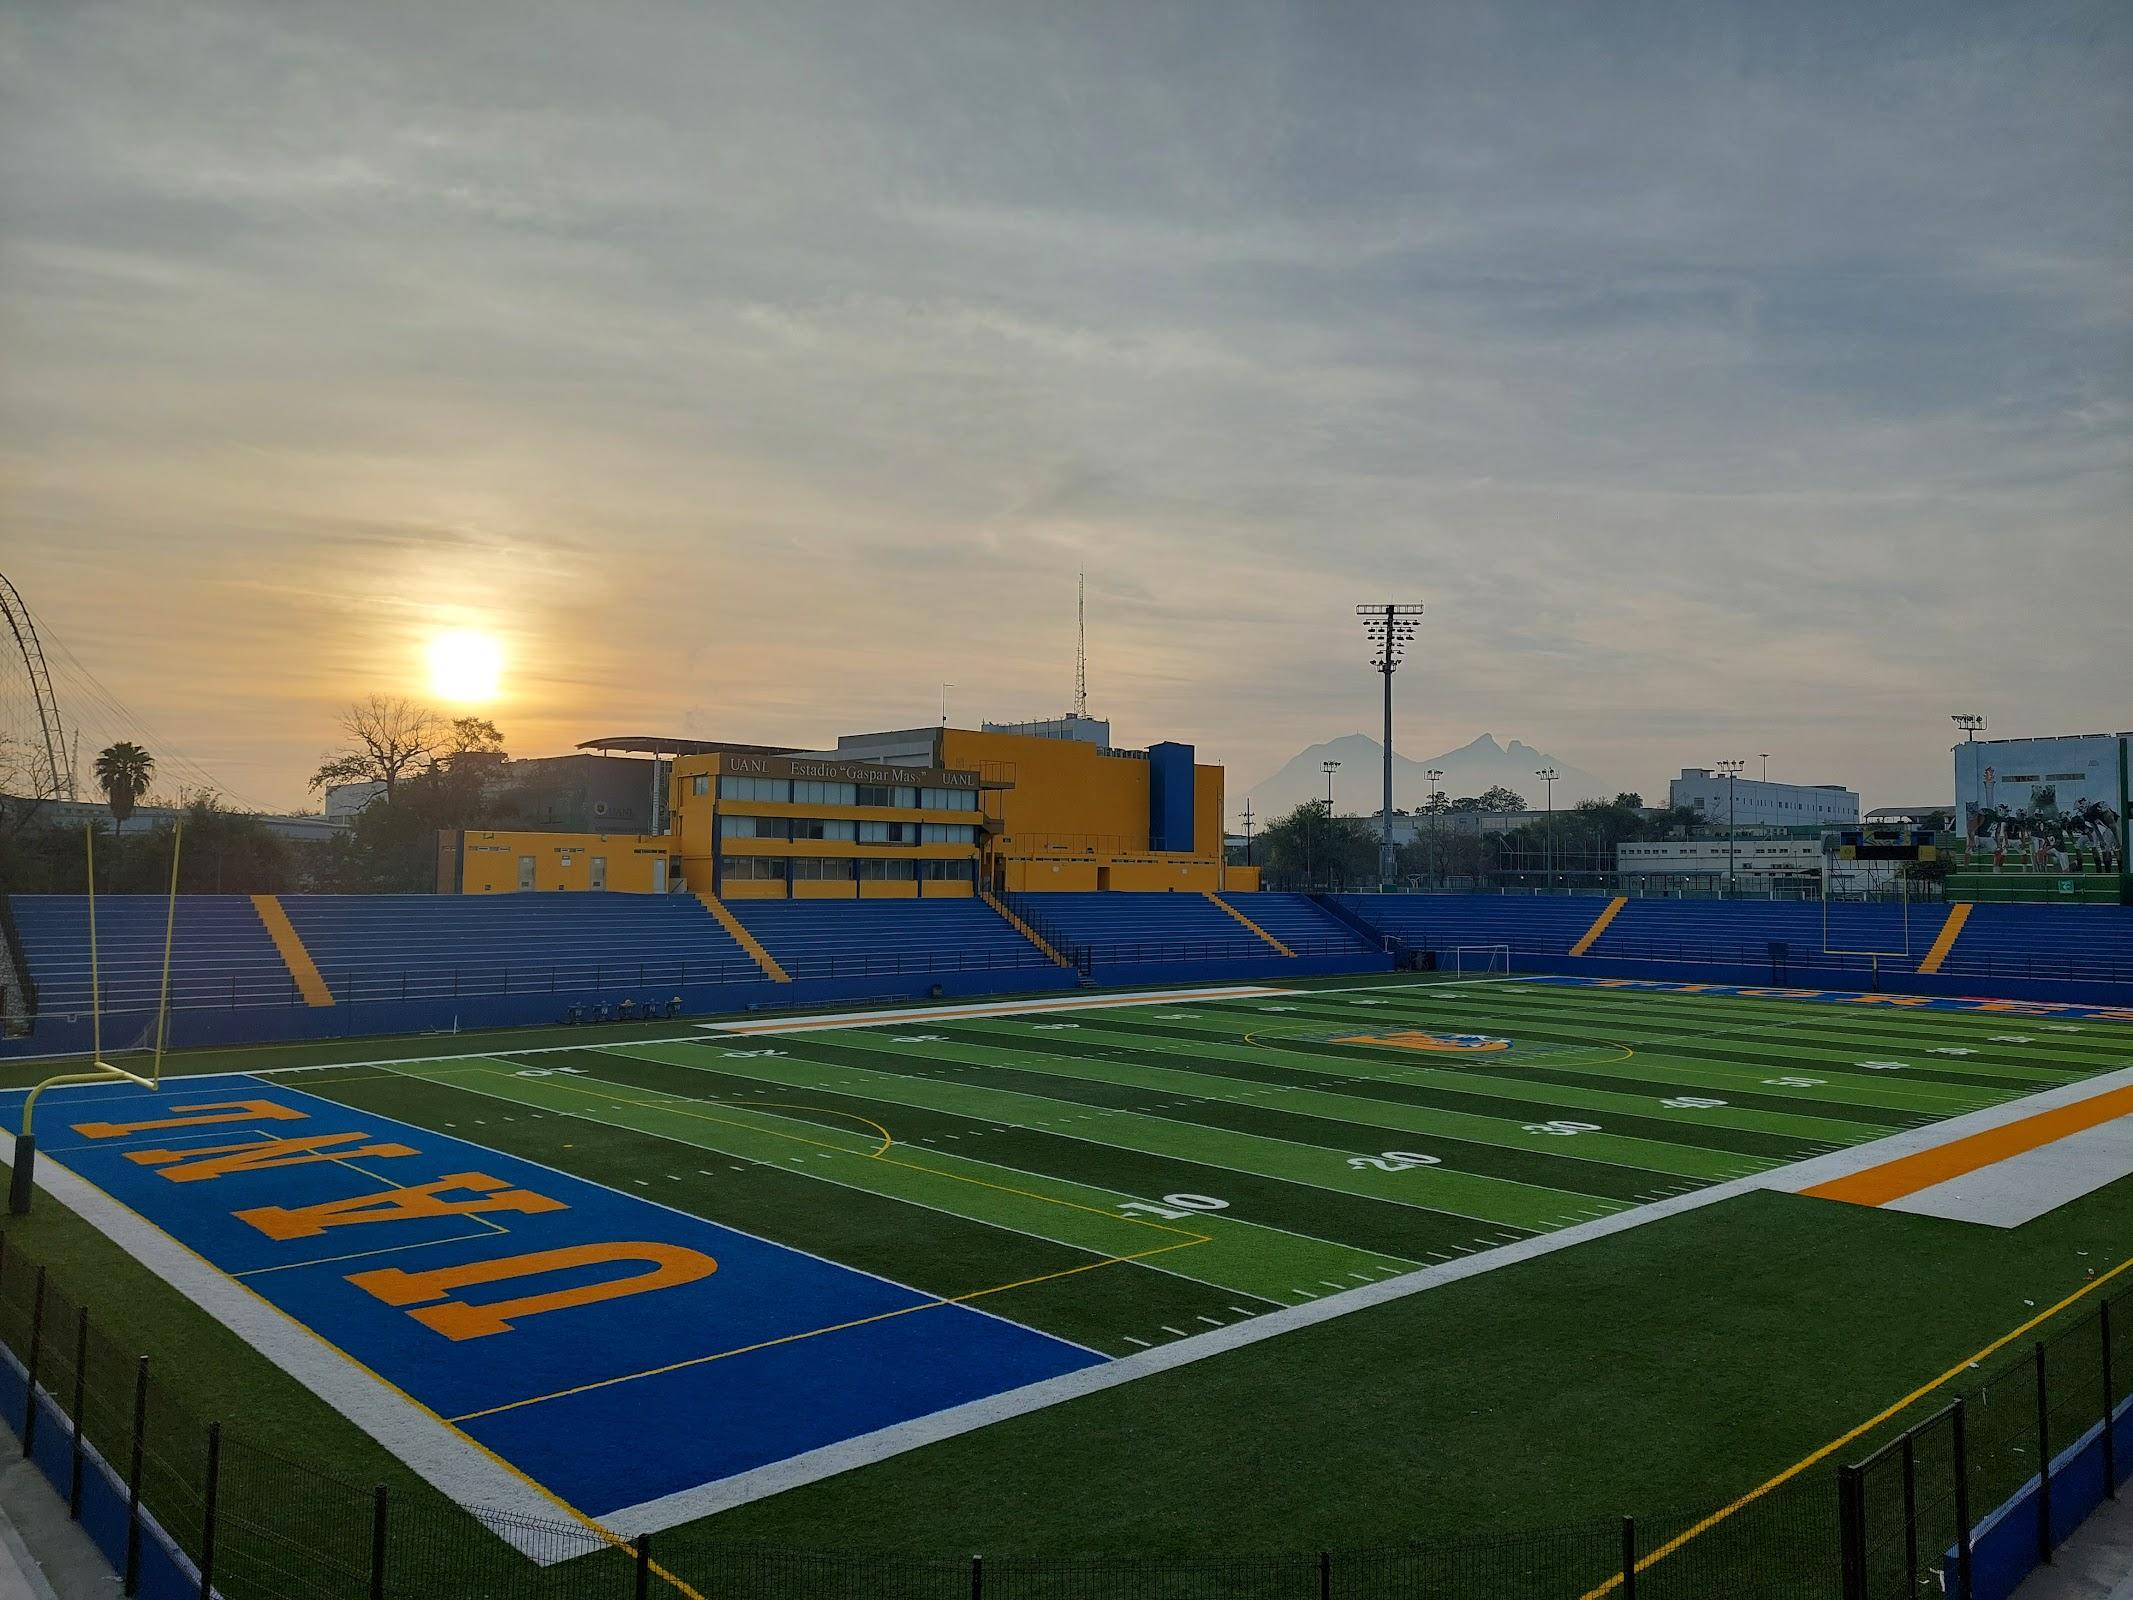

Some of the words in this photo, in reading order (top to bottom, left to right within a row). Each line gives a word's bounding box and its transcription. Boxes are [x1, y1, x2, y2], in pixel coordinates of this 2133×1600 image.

[730, 758, 770, 774] UANL
[791, 762, 837, 778] Estadio
[942, 773, 974, 787] UANL
[717, 1048, 790, 1059] 20
[514, 1066, 589, 1077] 10
[1760, 1076, 1829, 1088] 50
[1658, 1096, 1729, 1110] 40
[1521, 1120, 1603, 1136] 30
[1346, 1151, 1443, 1172] 20
[1116, 1193, 1231, 1220] 10
[69, 1099, 719, 1341] UANL
